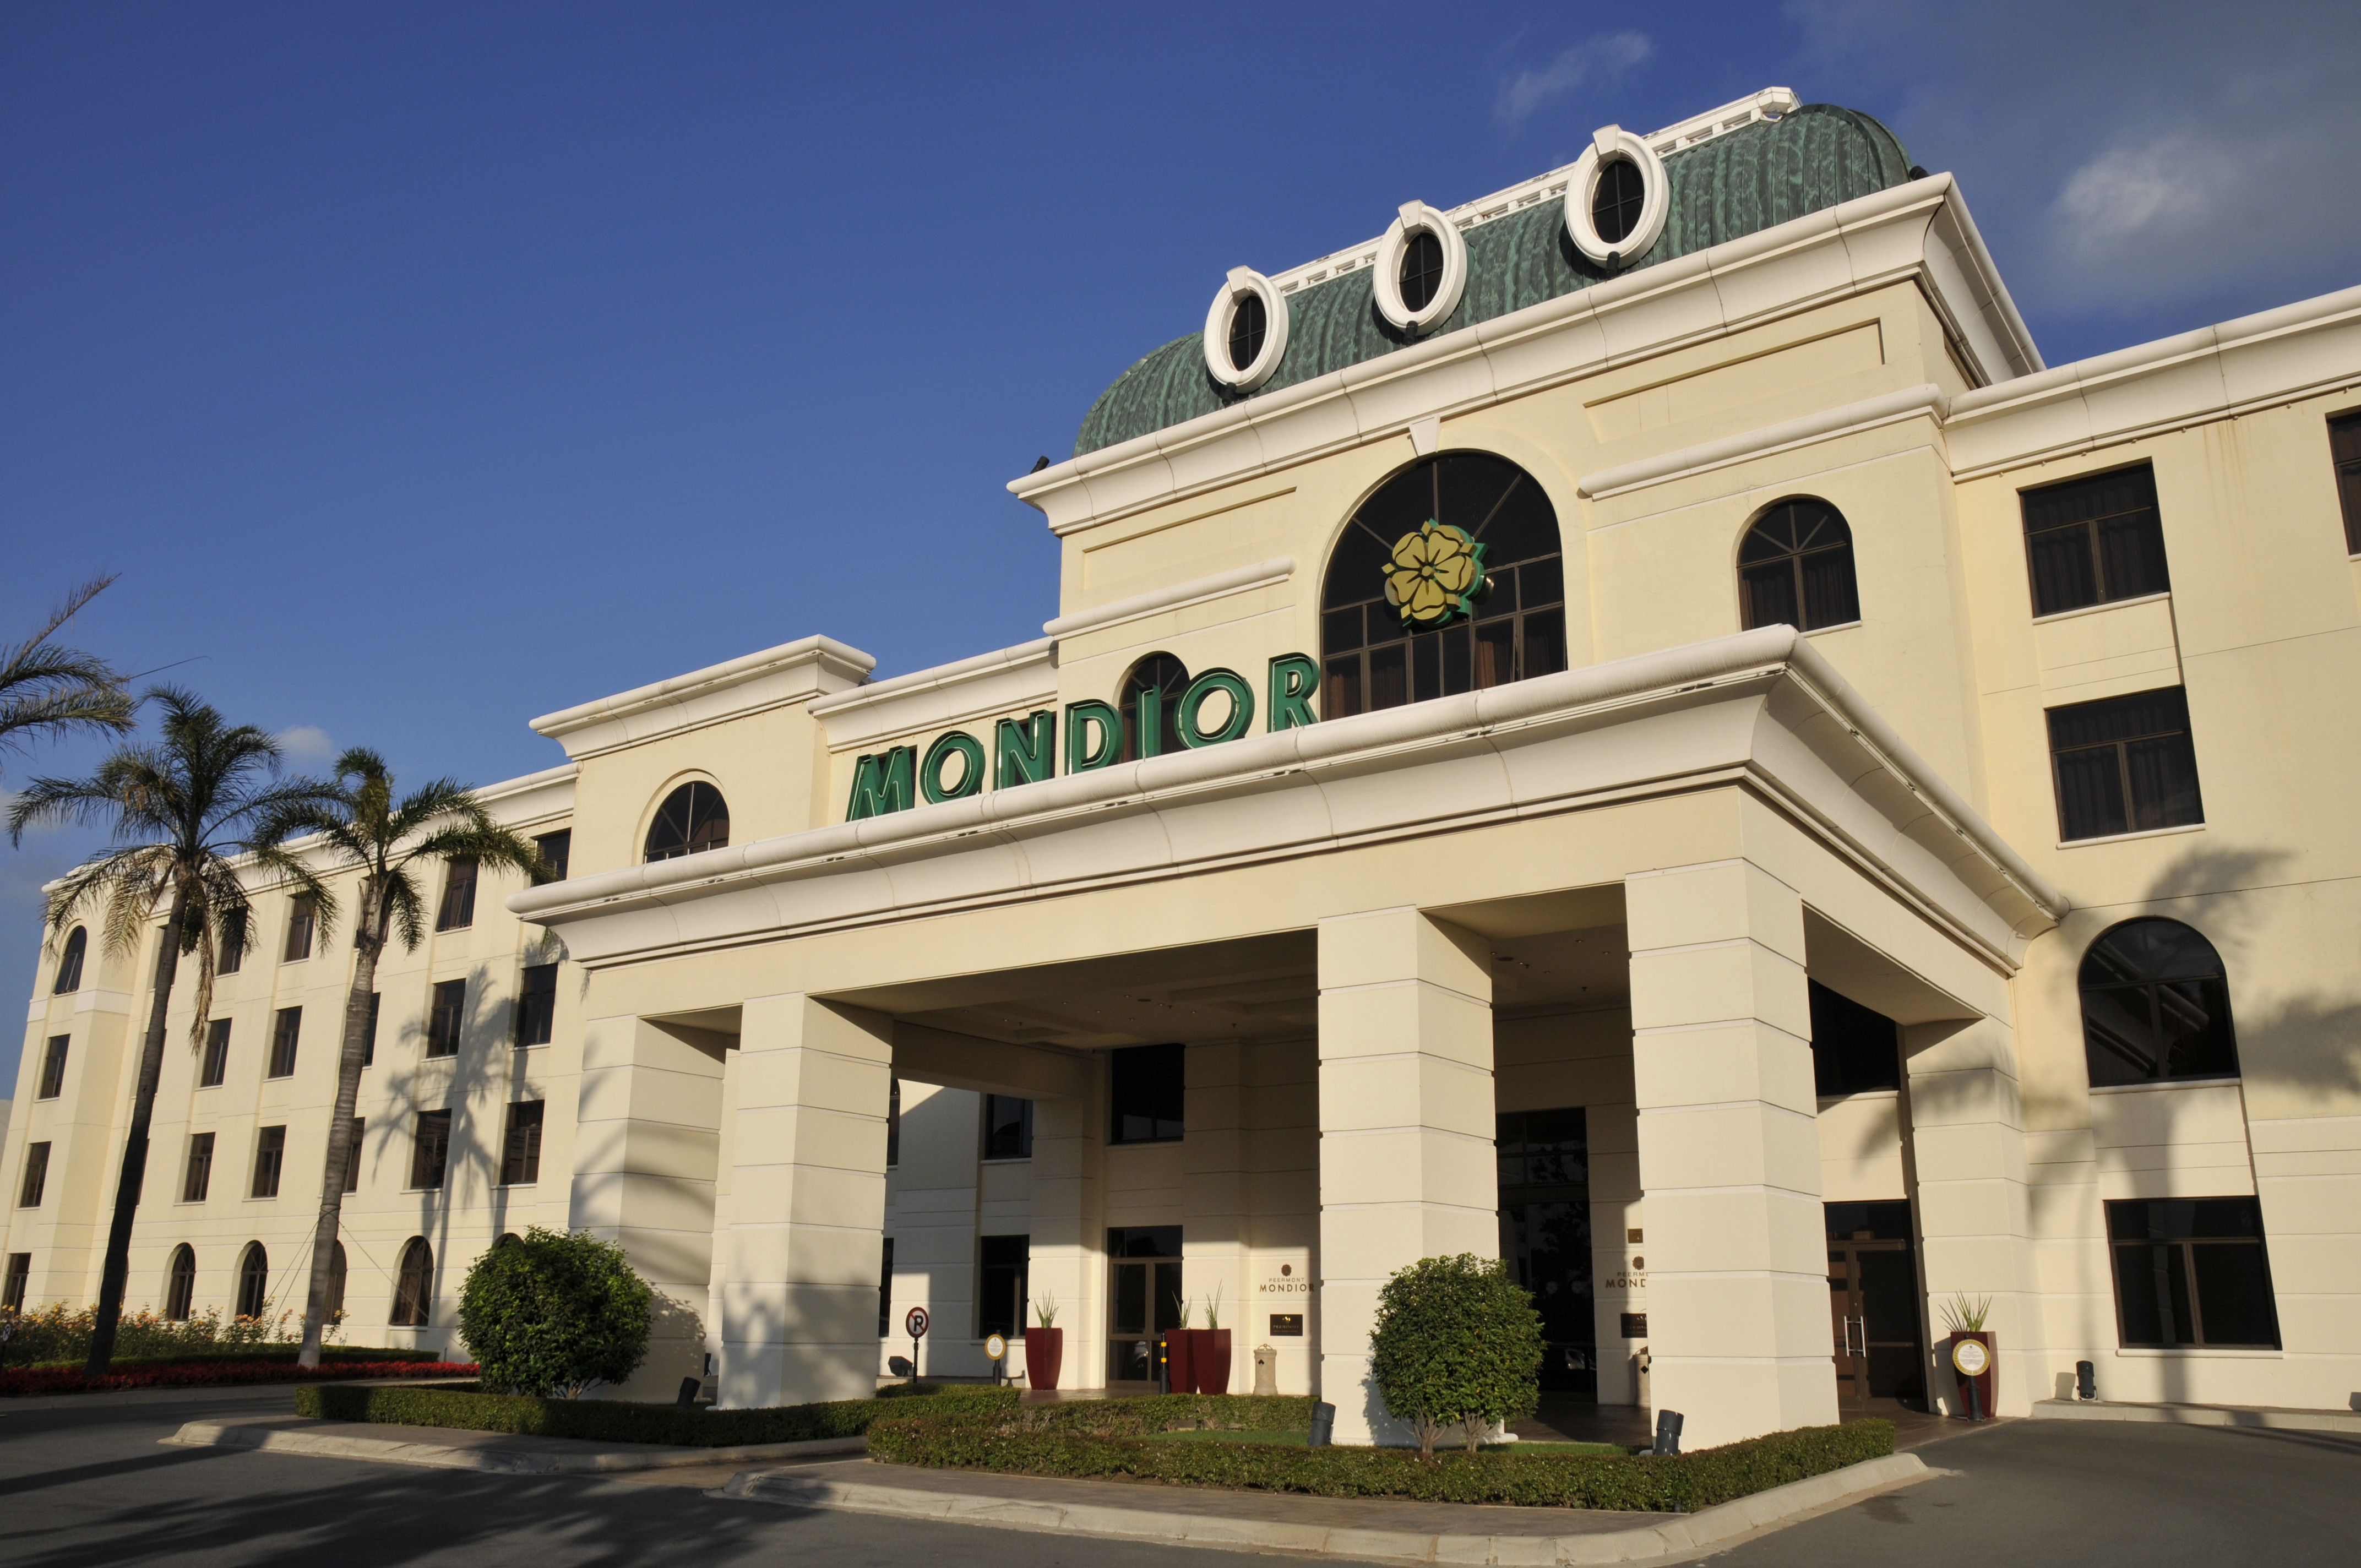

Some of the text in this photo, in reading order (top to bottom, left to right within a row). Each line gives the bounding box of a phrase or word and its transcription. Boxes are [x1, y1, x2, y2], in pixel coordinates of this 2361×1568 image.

[845, 652, 1320, 822] MONDIOR
[1259, 1283, 1314, 1292] MONDIOR
[914, 1315, 923, 1332] P
